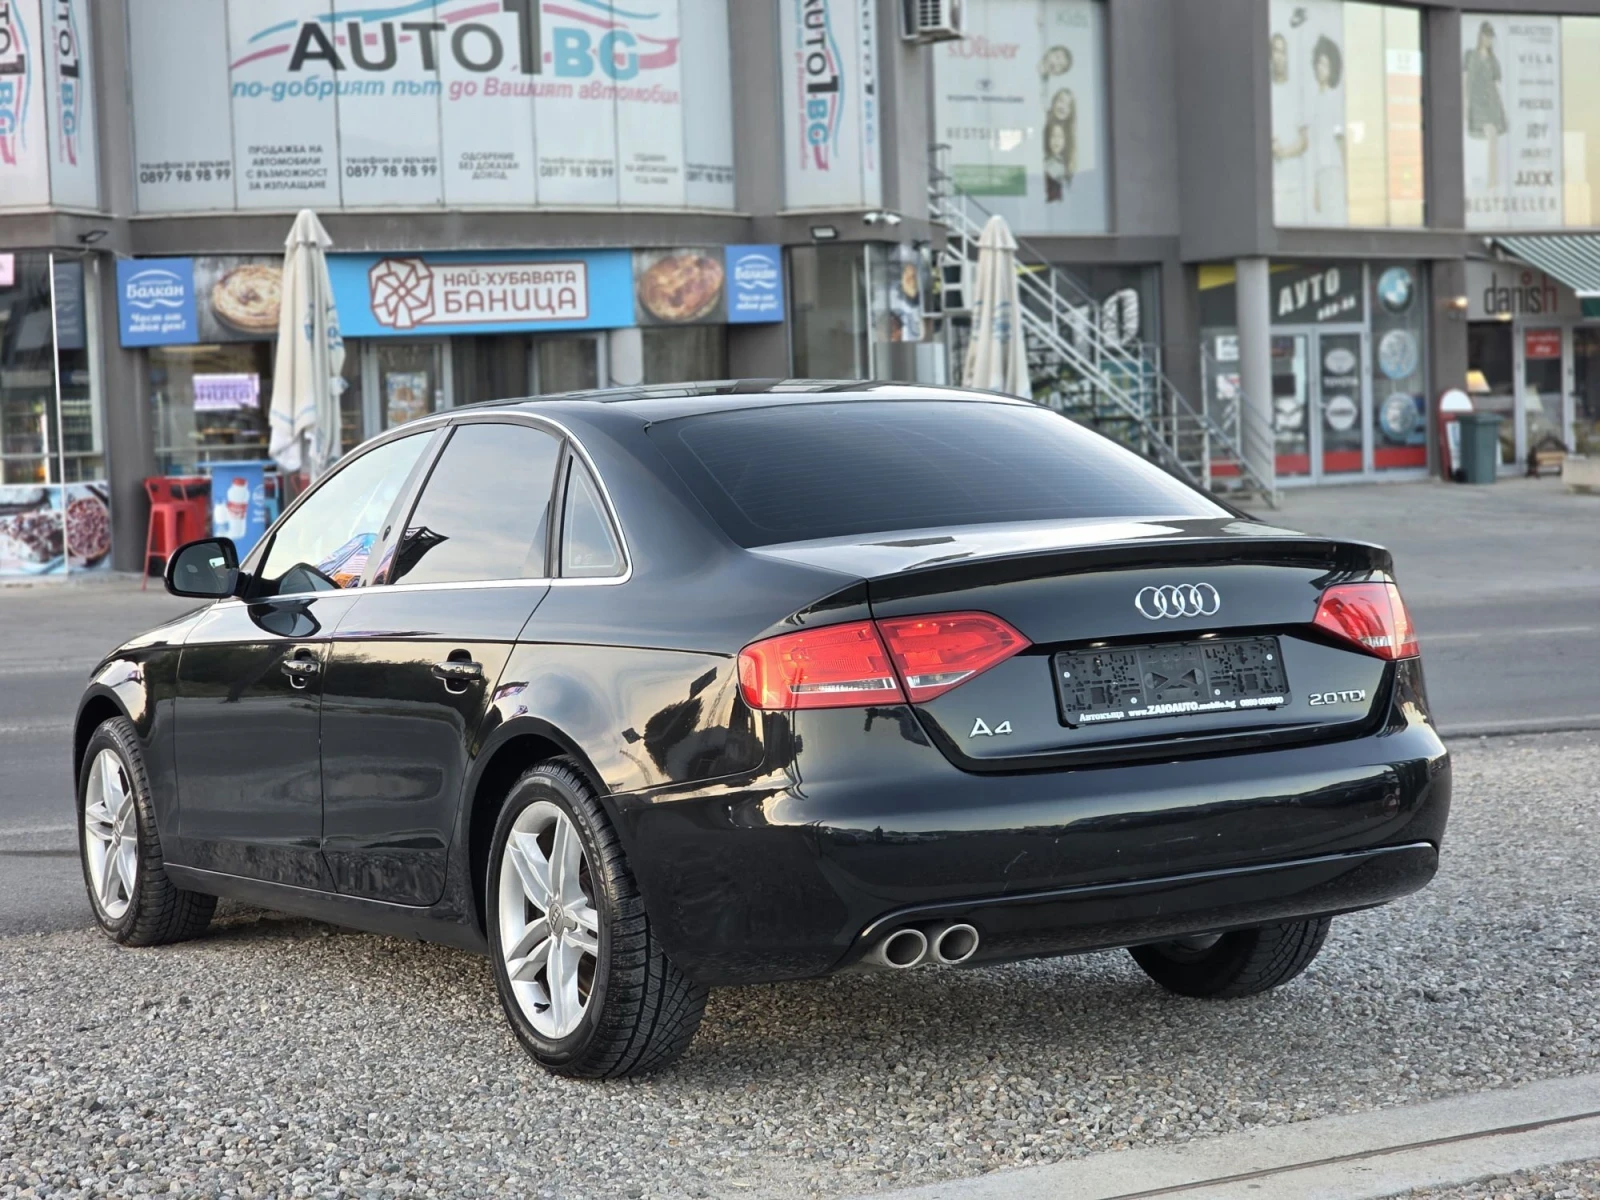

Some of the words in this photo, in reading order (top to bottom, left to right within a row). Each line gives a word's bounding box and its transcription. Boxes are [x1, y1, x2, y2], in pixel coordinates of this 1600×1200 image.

[232, 75, 385, 102] по-добрият
[392, 80, 442, 96] път
[449, 80, 477, 101] до
[248, 145, 306, 155] ПРОДАЖБА
[309, 145, 323, 154] НА
[252, 157, 321, 166] АВТОМОБИЛИ
[140, 169, 172, 184] 0897
[177, 169, 192, 183] 98
[196, 168, 211, 182] 98
[215, 168, 231, 181] 99
[346, 165, 378, 178] 0897
[382, 165, 398, 178] 98
[402, 165, 418, 178] 98
[422, 164, 437, 177] 99
[443, 269, 577, 287] НАЙ-ХУБАВАТА
[126, 284, 185, 299] Балкан
[1484, 270, 1558, 315] danish
[444, 287, 577, 315] БАНИЦА
[1079, 711, 1124, 722] Автокъща
[969, 717, 1013, 738] A4
